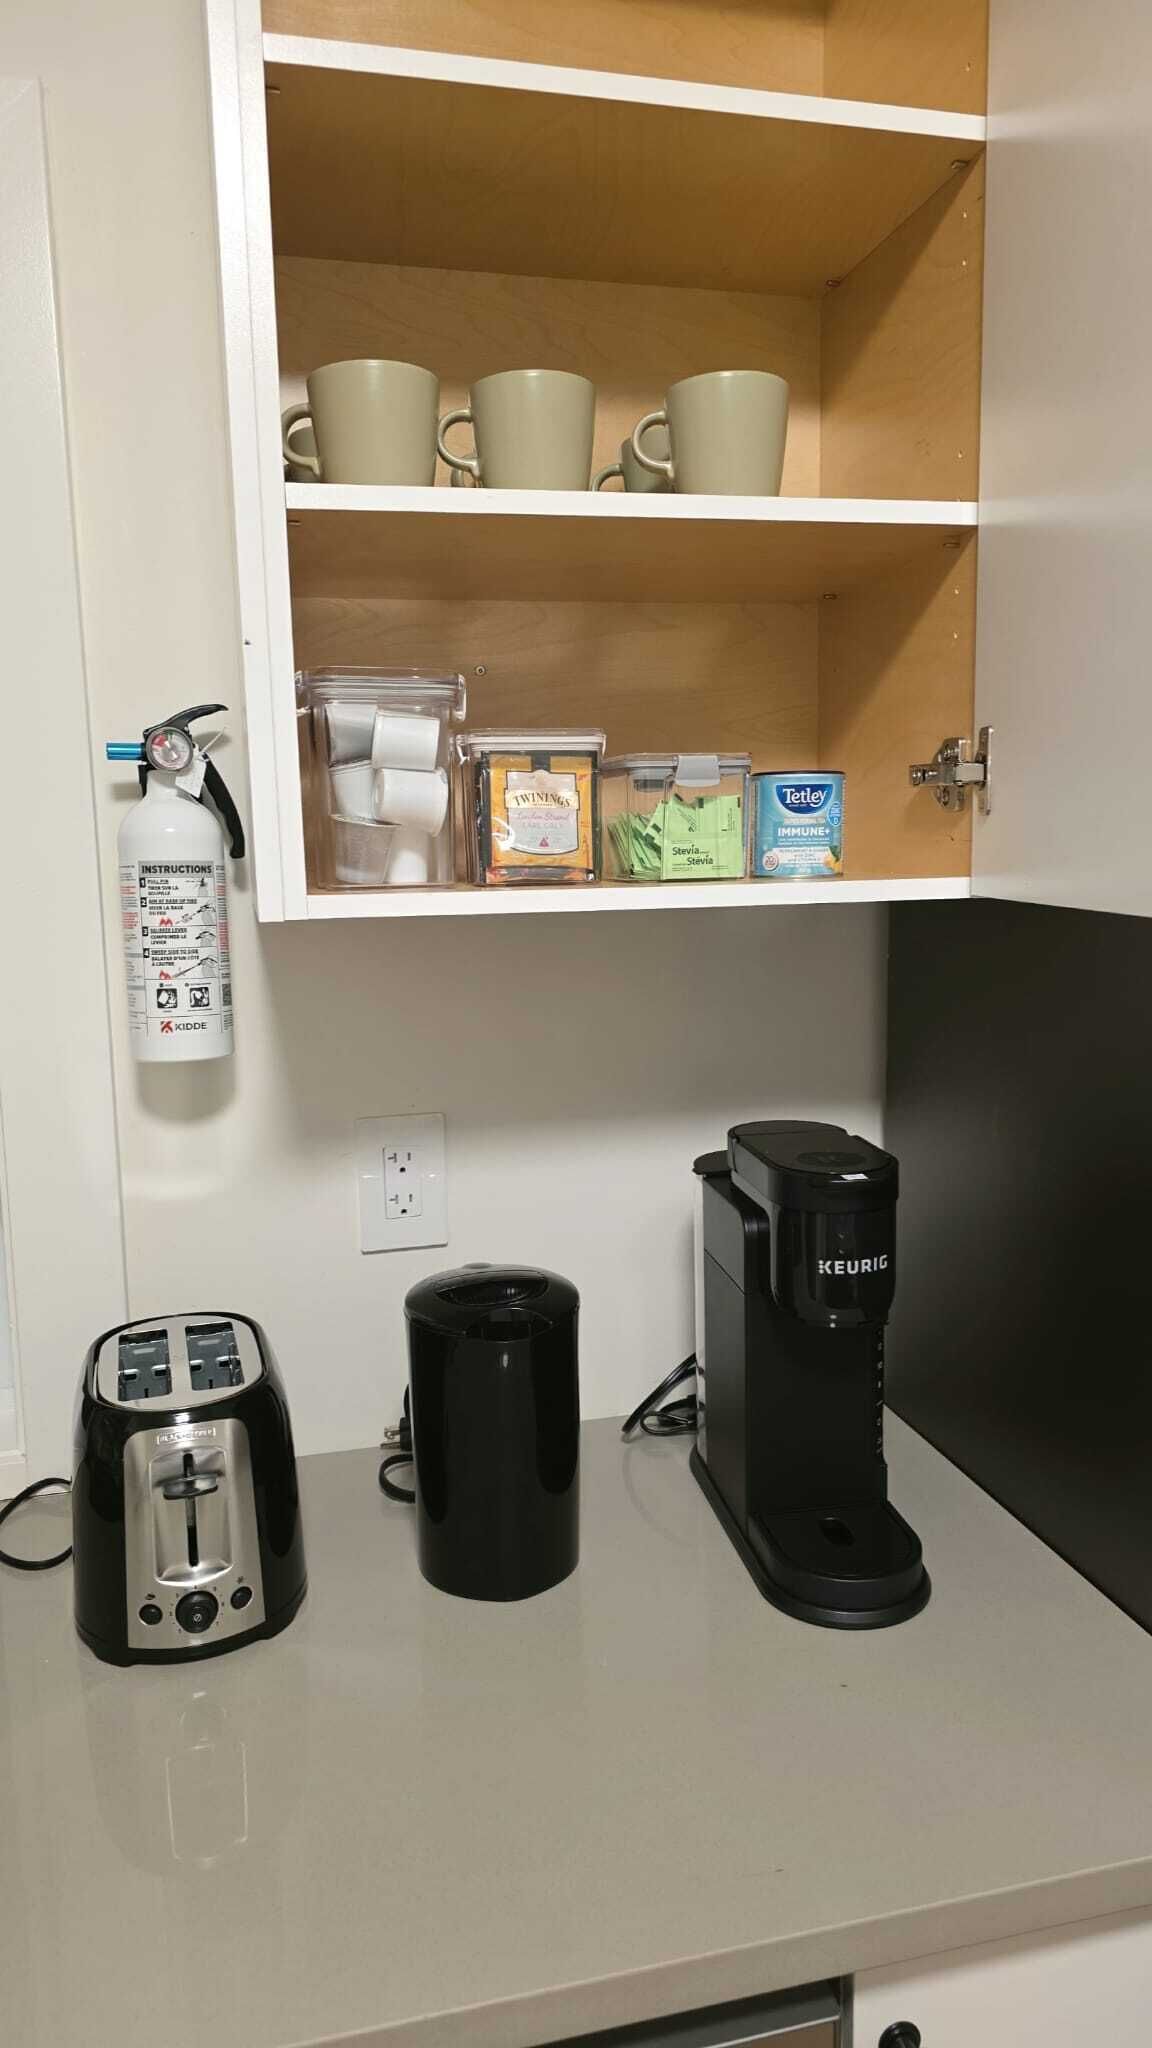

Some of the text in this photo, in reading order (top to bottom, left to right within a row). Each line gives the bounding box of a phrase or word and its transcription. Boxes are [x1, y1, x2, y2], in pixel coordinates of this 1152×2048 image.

[512, 791, 571, 808] TWININGS
[782, 787, 828, 808] Tetley
[777, 826, 831, 837] IMMUNE+
[672, 844, 700, 856] Stevia
[141, 864, 212, 874] INSTRUCTIONS
[175, 1021, 208, 1031] KIDDE
[818, 1254, 888, 1275] KEURIG
